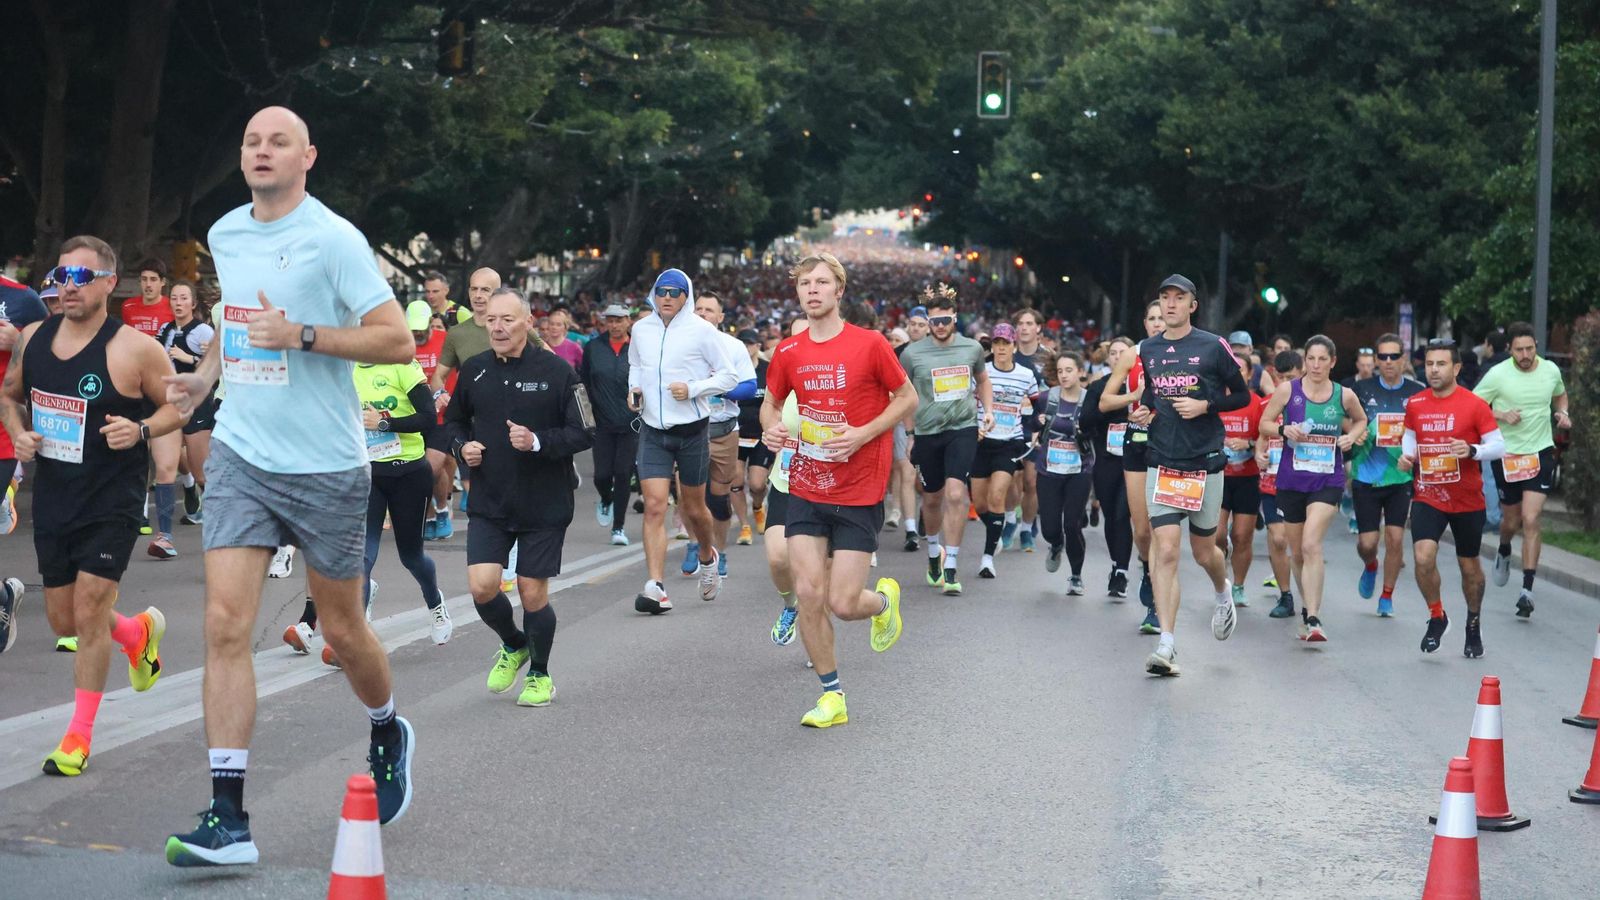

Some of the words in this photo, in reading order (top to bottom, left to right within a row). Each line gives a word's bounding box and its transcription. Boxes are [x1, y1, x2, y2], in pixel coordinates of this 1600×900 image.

[802, 364, 834, 372] GENERALI
[803, 378, 836, 391] MÁLAGA
[1152, 375, 1199, 388] MADRID
[40, 394, 80, 412] GENERALI
[809, 408, 843, 422] GENERALI
[37, 414, 70, 432] 16870
[1169, 480, 1192, 491] 4867
